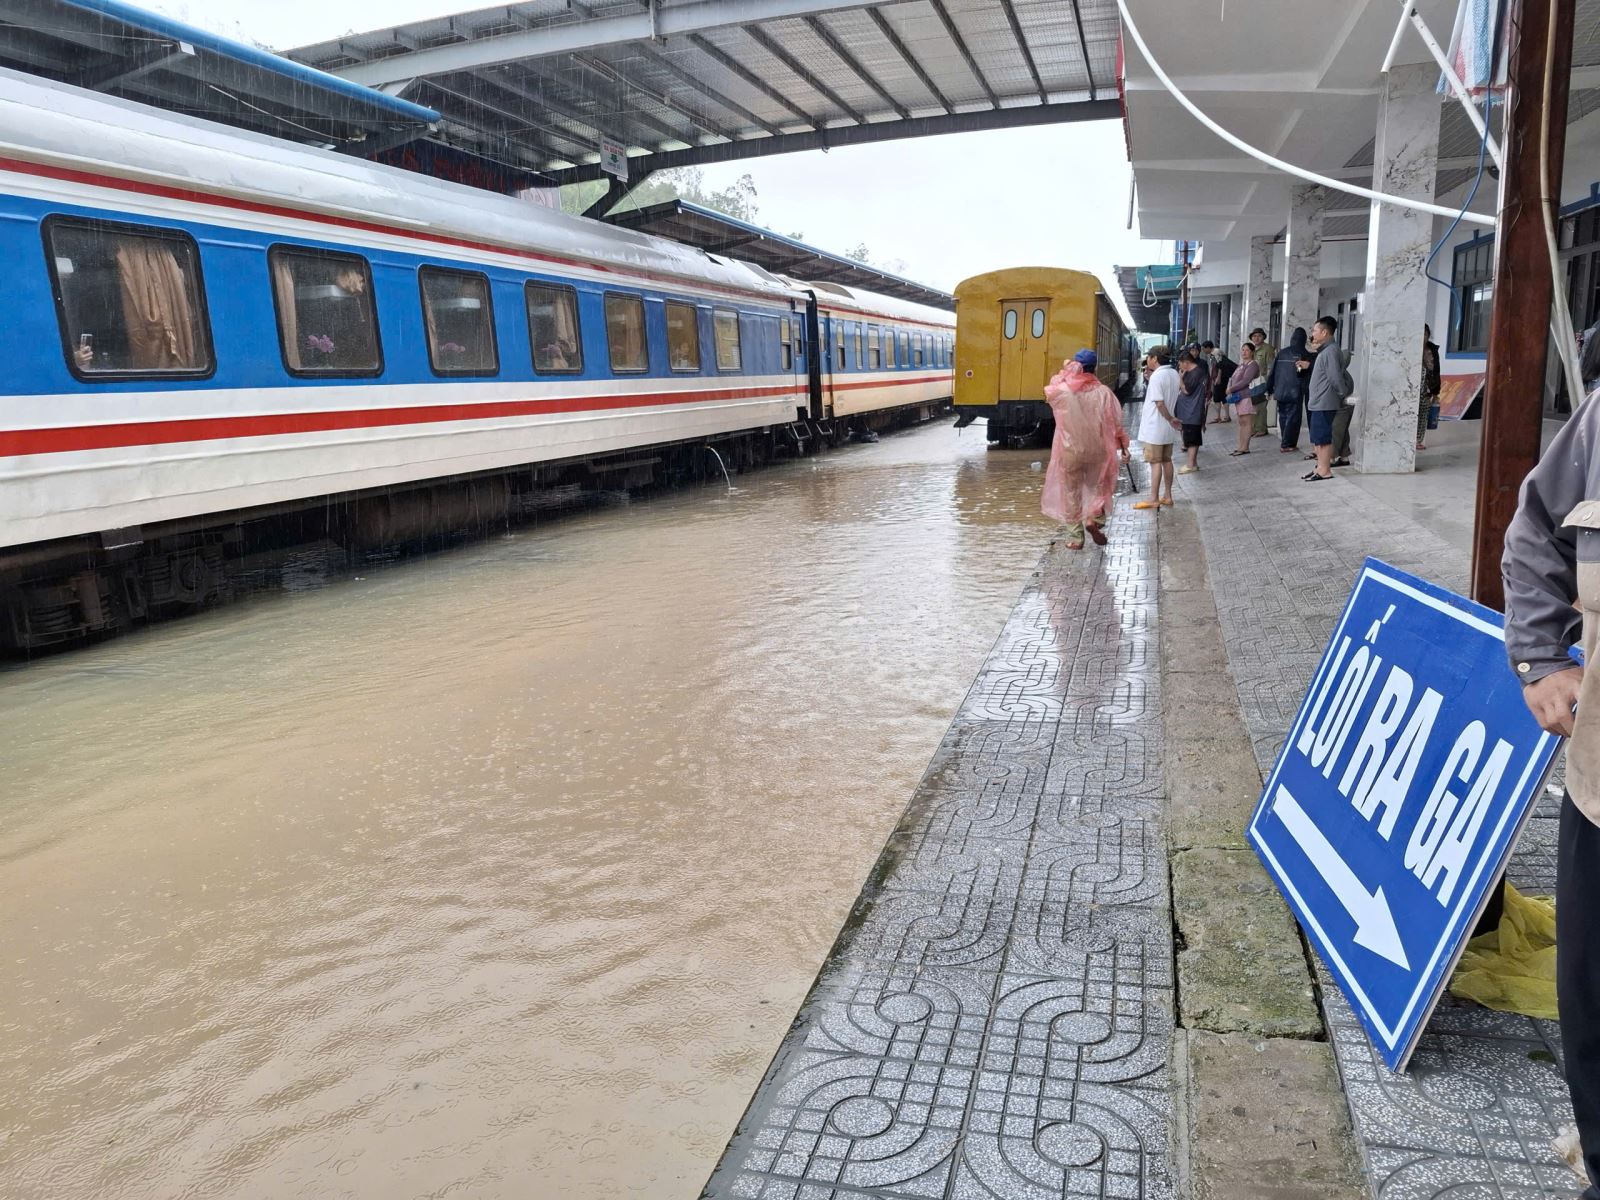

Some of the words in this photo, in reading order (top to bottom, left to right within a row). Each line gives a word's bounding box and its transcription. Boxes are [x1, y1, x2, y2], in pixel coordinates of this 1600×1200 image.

[1296, 604, 1396, 779] LỐI
[1337, 664, 1444, 842] RA
[1404, 720, 1514, 908] GA
